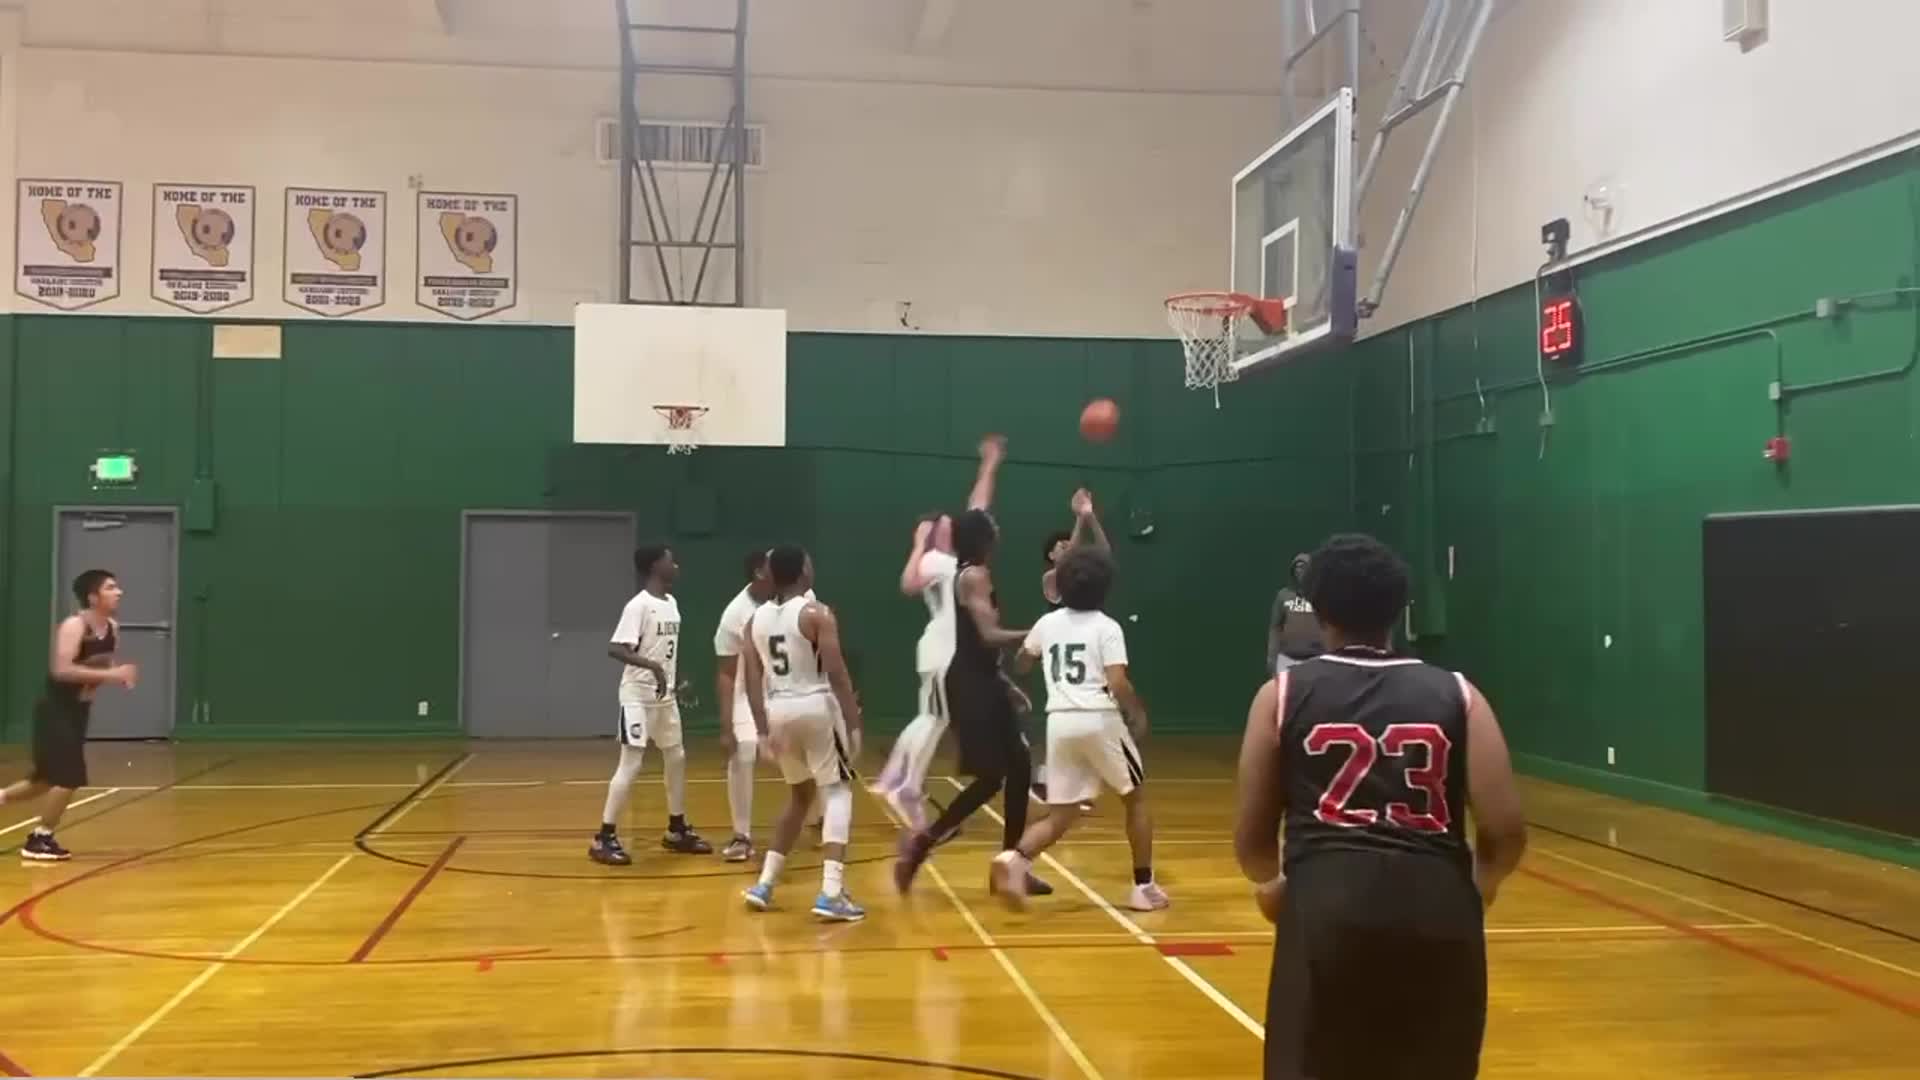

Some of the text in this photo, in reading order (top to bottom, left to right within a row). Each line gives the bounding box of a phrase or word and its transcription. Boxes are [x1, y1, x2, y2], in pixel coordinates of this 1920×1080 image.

[28, 185, 112, 199] HOME OF THE
[163, 191, 246, 204] HOME OF THE
[295, 195, 377, 208] HOME OF THE
[427, 199, 508, 212] HOME OF THE
[1543, 301, 1571, 353] 25
[665, 639, 674, 659] 3
[768, 635, 790, 676] 5
[1049, 643, 1086, 685] 15
[1304, 723, 1452, 833] 23
